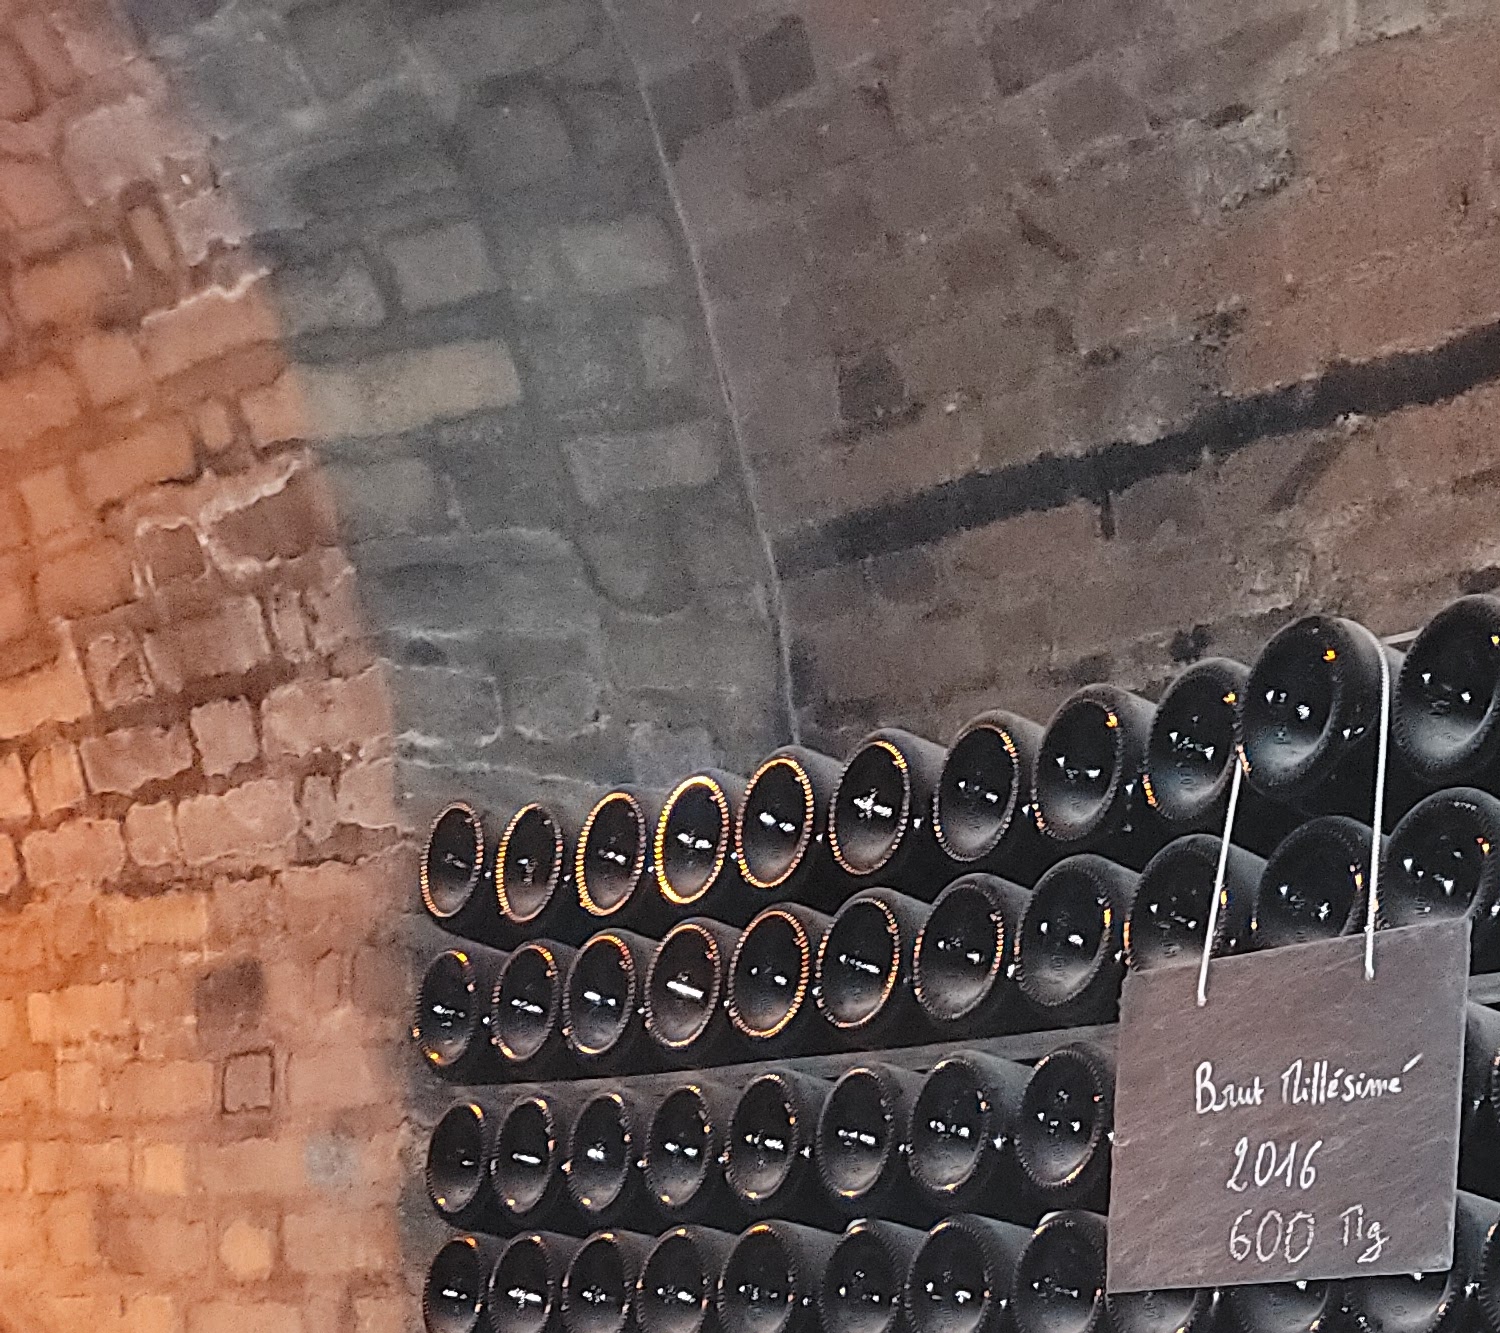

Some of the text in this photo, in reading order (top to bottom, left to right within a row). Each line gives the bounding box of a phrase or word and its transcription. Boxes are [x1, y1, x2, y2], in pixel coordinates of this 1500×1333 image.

[1194, 1053, 1424, 1114] Brut Millésimé
[1226, 1136, 1323, 1192] 2016
[1228, 1208, 1316, 1263] 600
